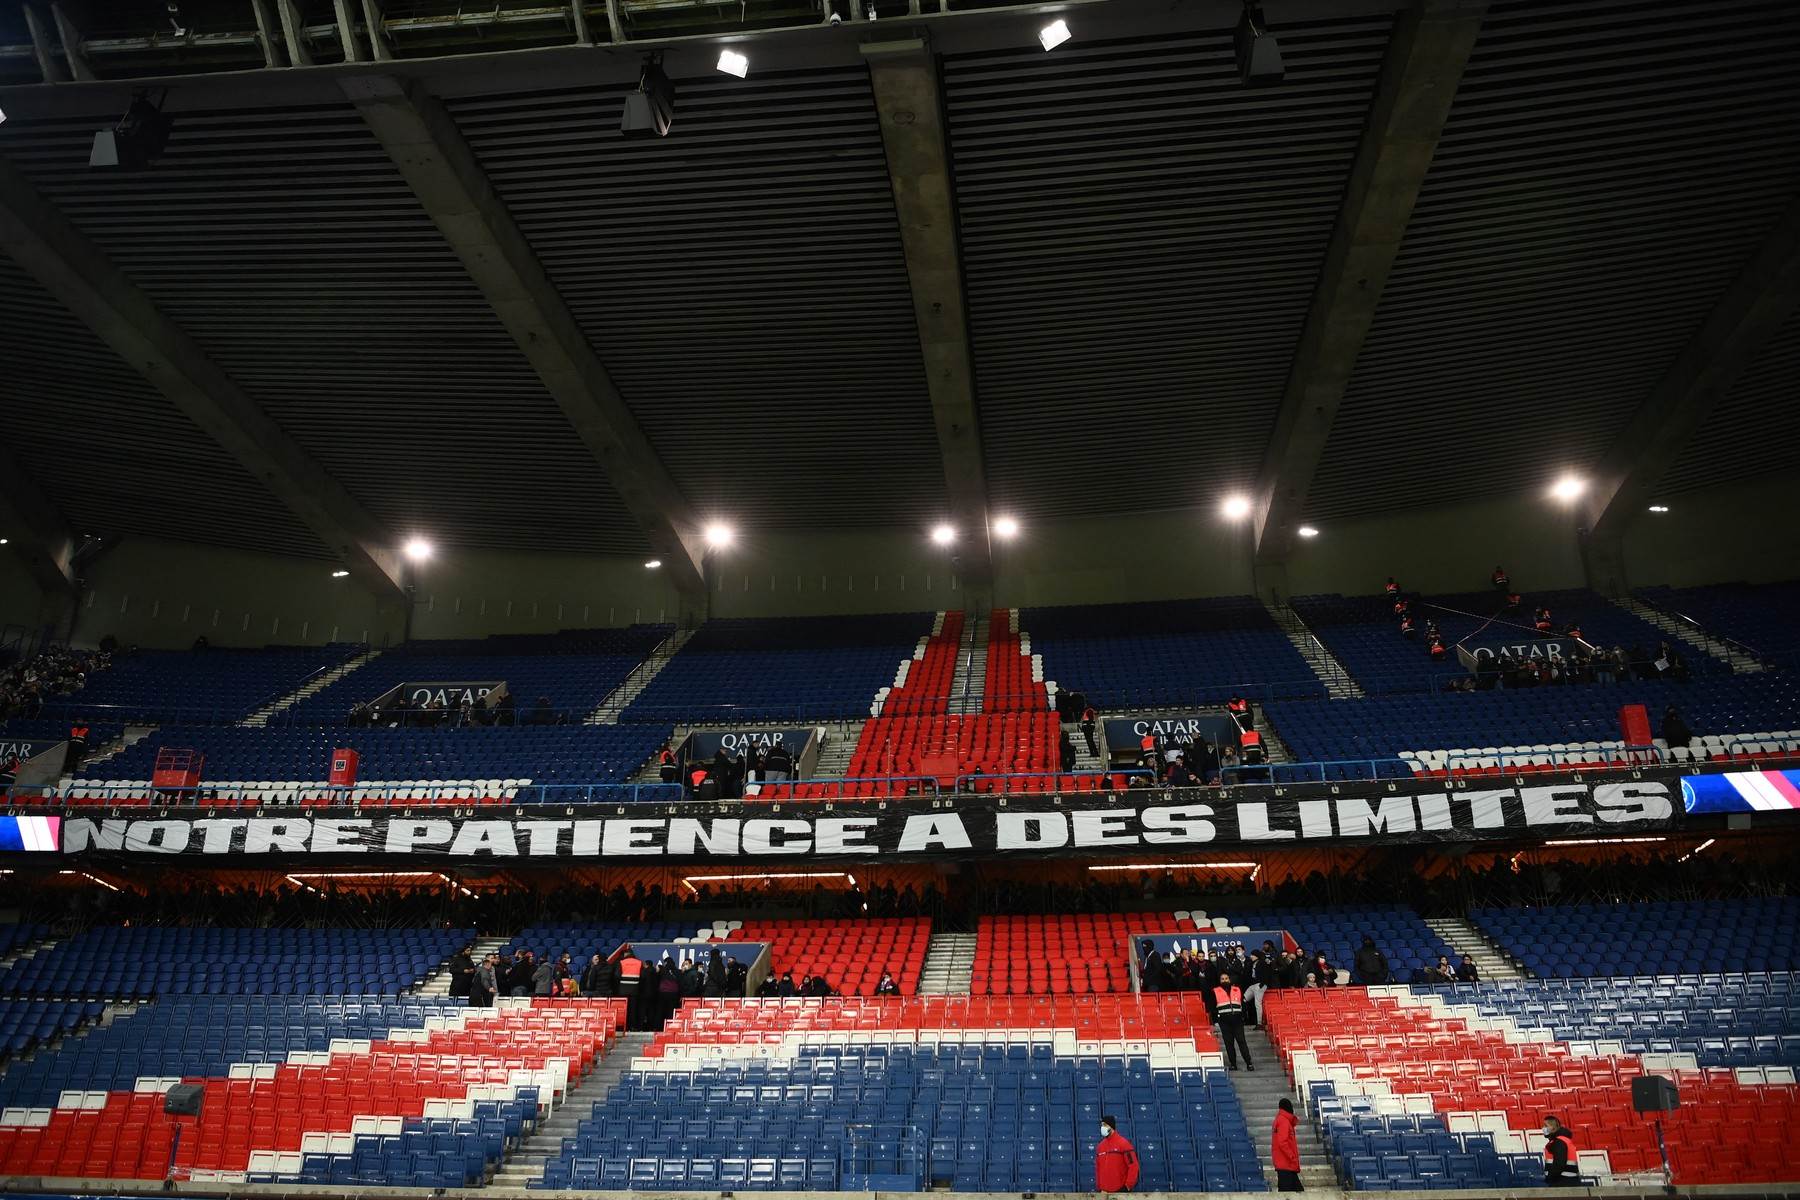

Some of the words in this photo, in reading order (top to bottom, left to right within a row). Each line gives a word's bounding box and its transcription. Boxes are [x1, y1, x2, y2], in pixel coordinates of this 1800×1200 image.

[1133, 719, 1201, 736] QATAR
[63, 818, 370, 854] NOTRE
[386, 817, 879, 856] PATIENCE
[897, 813, 973, 852] A
[997, 804, 1216, 850] DES
[1238, 781, 1673, 841] LIMITES
